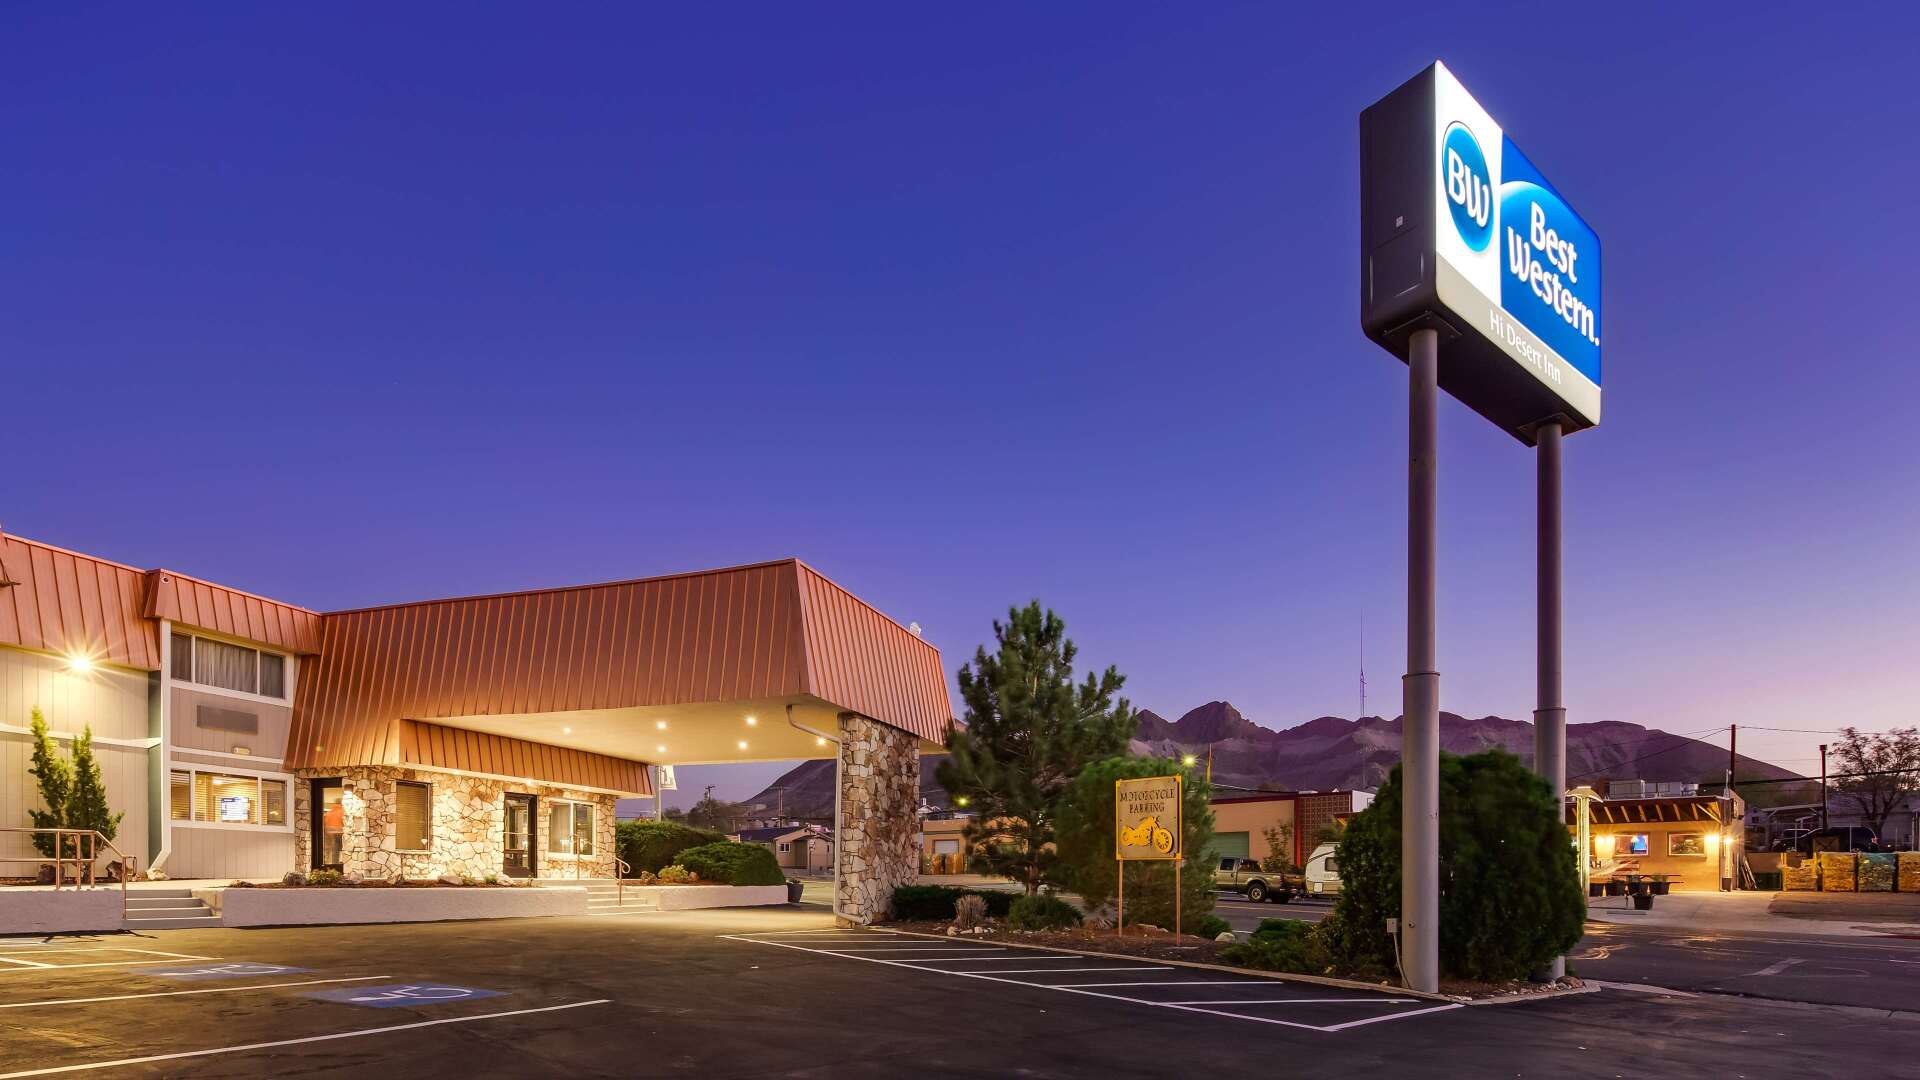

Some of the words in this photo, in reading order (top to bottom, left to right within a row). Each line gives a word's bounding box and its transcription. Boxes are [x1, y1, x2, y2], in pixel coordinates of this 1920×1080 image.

[1448, 147, 1490, 228] BW
[1530, 201, 1578, 284] Best
[1490, 309, 1504, 338] Hi
[1507, 323, 1542, 369] Desert
[1544, 353, 1561, 385] Inn
[1120, 789, 1175, 801] MOTORCYCLE
[1129, 802, 1165, 814] PARKING
